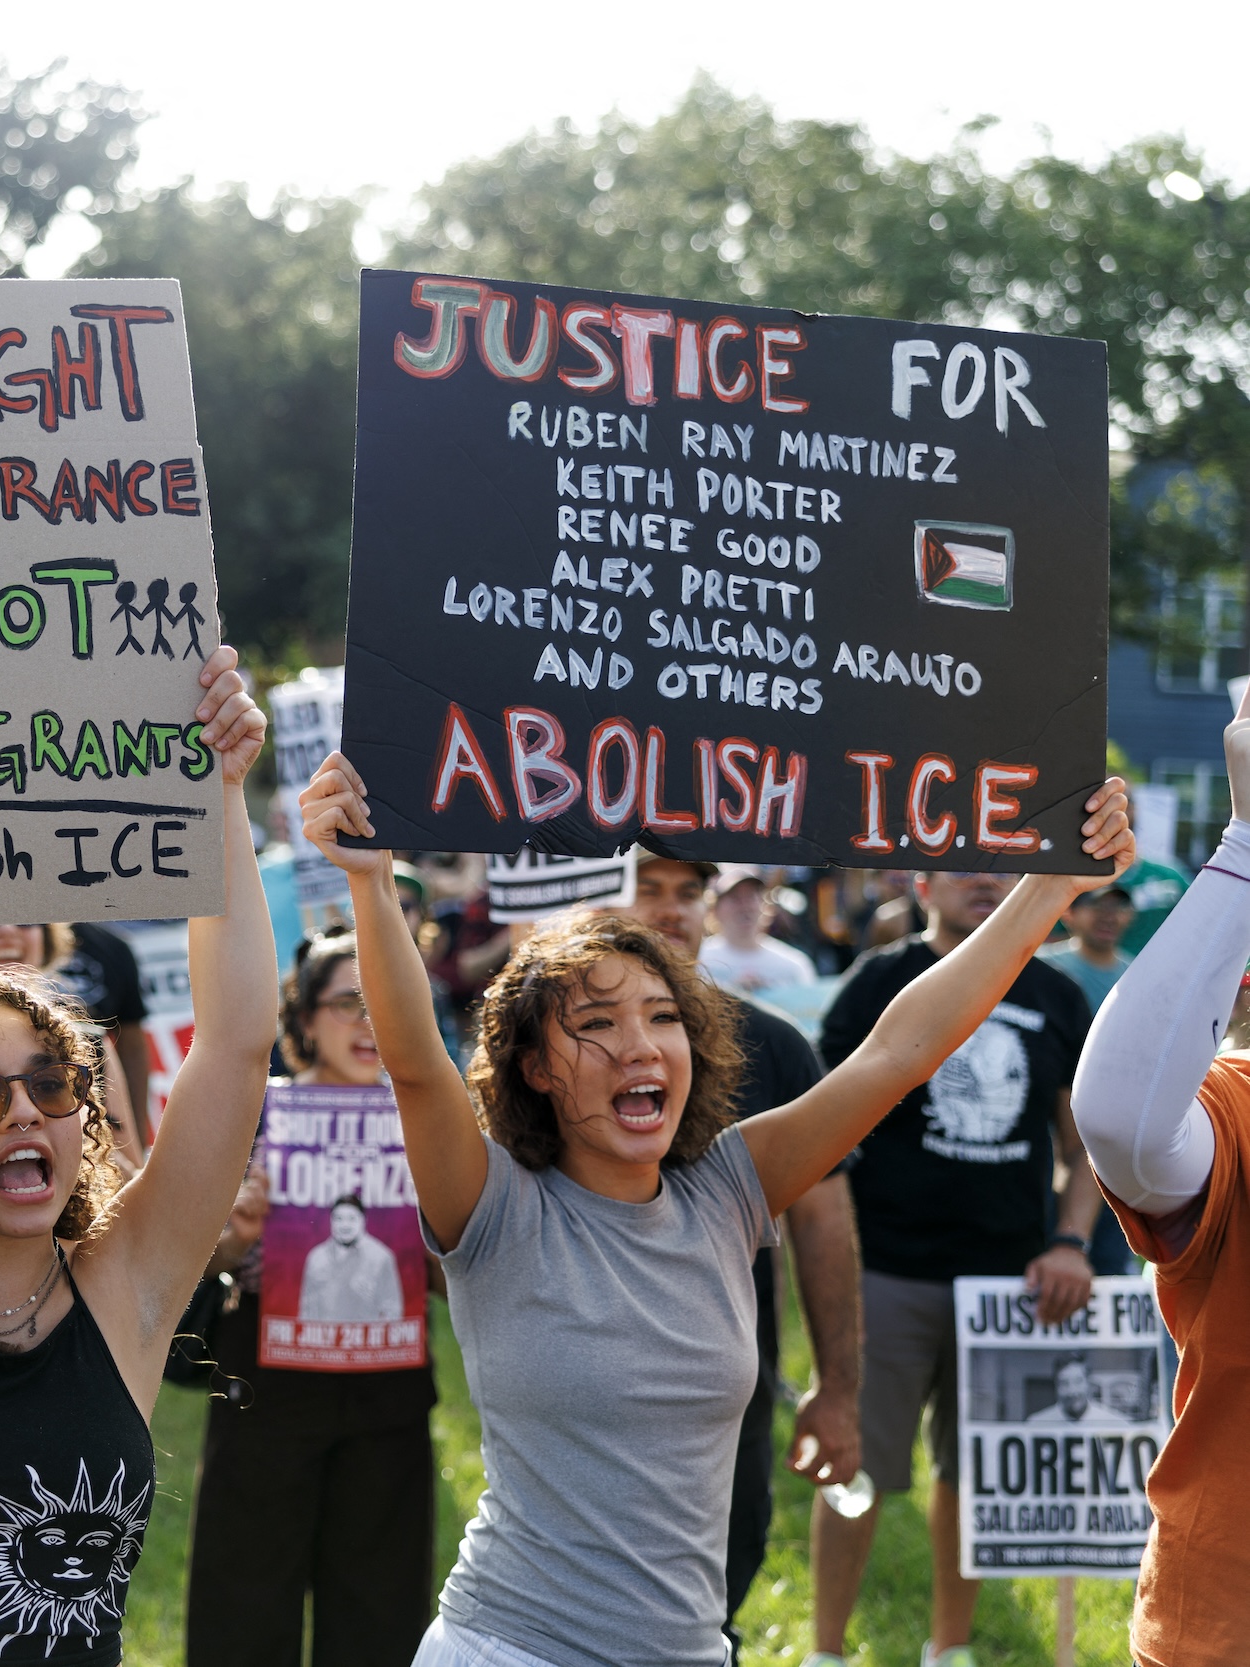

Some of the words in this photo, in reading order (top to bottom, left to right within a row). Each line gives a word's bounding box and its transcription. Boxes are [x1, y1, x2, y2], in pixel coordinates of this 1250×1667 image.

[394, 276, 810, 415] JUSTICE
[890, 339, 1048, 437] FOR
[507, 400, 649, 452] RUBEN
[681, 420, 755, 463] RAY
[778, 430, 959, 485] MARTINEZ
[556, 457, 674, 509] KEITH
[696, 467, 842, 524] PORTER
[557, 504, 695, 553] RENEE
[716, 527, 821, 574] GOOD
[550, 549, 654, 600] ALEX
[681, 563, 815, 621] PRETTI
[443, 575, 623, 641] LORENZO
[646, 608, 819, 669] SALGADO
[832, 641, 983, 698] ARAUJO
[533, 641, 635, 691] AND
[656, 659, 824, 715] OTHERS
[430, 700, 810, 839] ABOLISH
[844, 750, 1054, 857] I.C.E.
[54, 821, 190, 886] ICE
[968, 1293, 1099, 1336] JUSCE
[1112, 1293, 1156, 1334] FOR
[971, 1435, 1158, 1497] LORENZO
[974, 1504, 1076, 1533] SALGADO
[1087, 1504, 1151, 1533] ARAUJ
